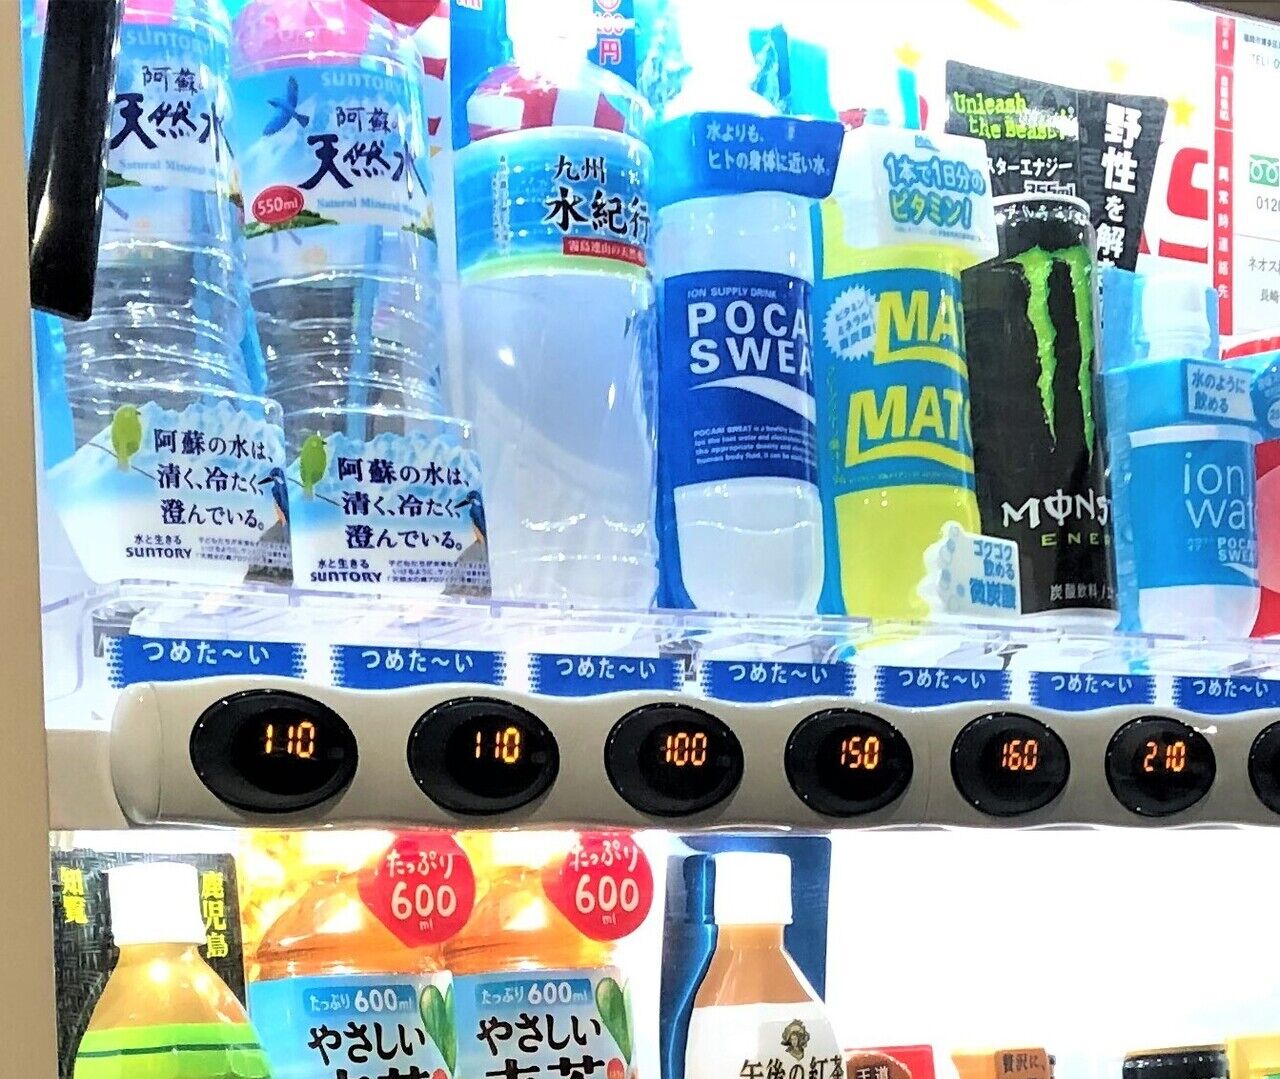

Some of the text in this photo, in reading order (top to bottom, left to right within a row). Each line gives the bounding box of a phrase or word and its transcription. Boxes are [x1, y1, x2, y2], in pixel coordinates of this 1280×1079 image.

[600, 40, 621, 65] 円
[954, 91, 1027, 115] Unleash
[110, 93, 234, 162] 天然水
[336, 106, 391, 134] 阿蘇
[970, 116, 1000, 139] the
[297, 134, 427, 199] 天然水
[555, 155, 605, 183] 九州
[256, 195, 299, 217] 550ml
[544, 186, 650, 243] 水紀行
[688, 288, 777, 299] ION SUPPLY DRINK
[688, 300, 813, 344] POCA
[873, 290, 965, 365] MA
[1192, 368, 1247, 394] 水のように
[1194, 391, 1229, 413] 飲める
[845, 385, 973, 468] MAT
[153, 428, 273, 463] 阿蘇の水は、
[157, 463, 264, 494] 清く、冷たく、
[337, 457, 470, 488] 阿蘇の水は、
[1183, 451, 1244, 495] ion
[161, 499, 265, 530] 澄んでいる。
[342, 491, 460, 519] 清く、冷たく、
[125, 546, 191, 559] SUNTORY
[134, 533, 182, 546] 水と生きる
[346, 524, 463, 551] 澄んでいる。
[974, 540, 1012, 561] ゴクゴク
[310, 571, 382, 583] SUNTORY
[317, 559, 370, 569] 水と生きる
[264, 720, 316, 759] 110
[475, 726, 521, 764] 110
[664, 732, 707, 768] 100
[840, 736, 879, 770] 150
[1001, 739, 1038, 770] 160
[1142, 741, 1186, 773] 210
[386, 851, 453, 878] たっぷり
[569, 840, 639, 869] たっぷり
[391, 882, 458, 920] 600
[575, 875, 640, 914] 600
[201, 870, 229, 959] 鹿児島
[419, 919, 434, 931] ml
[601, 913, 617, 926] ml
[310, 993, 351, 1012] たっぷり
[481, 985, 524, 1005] たっぷり
[307, 1020, 426, 1067] やさしい
[477, 1012, 601, 1058] やさしい
